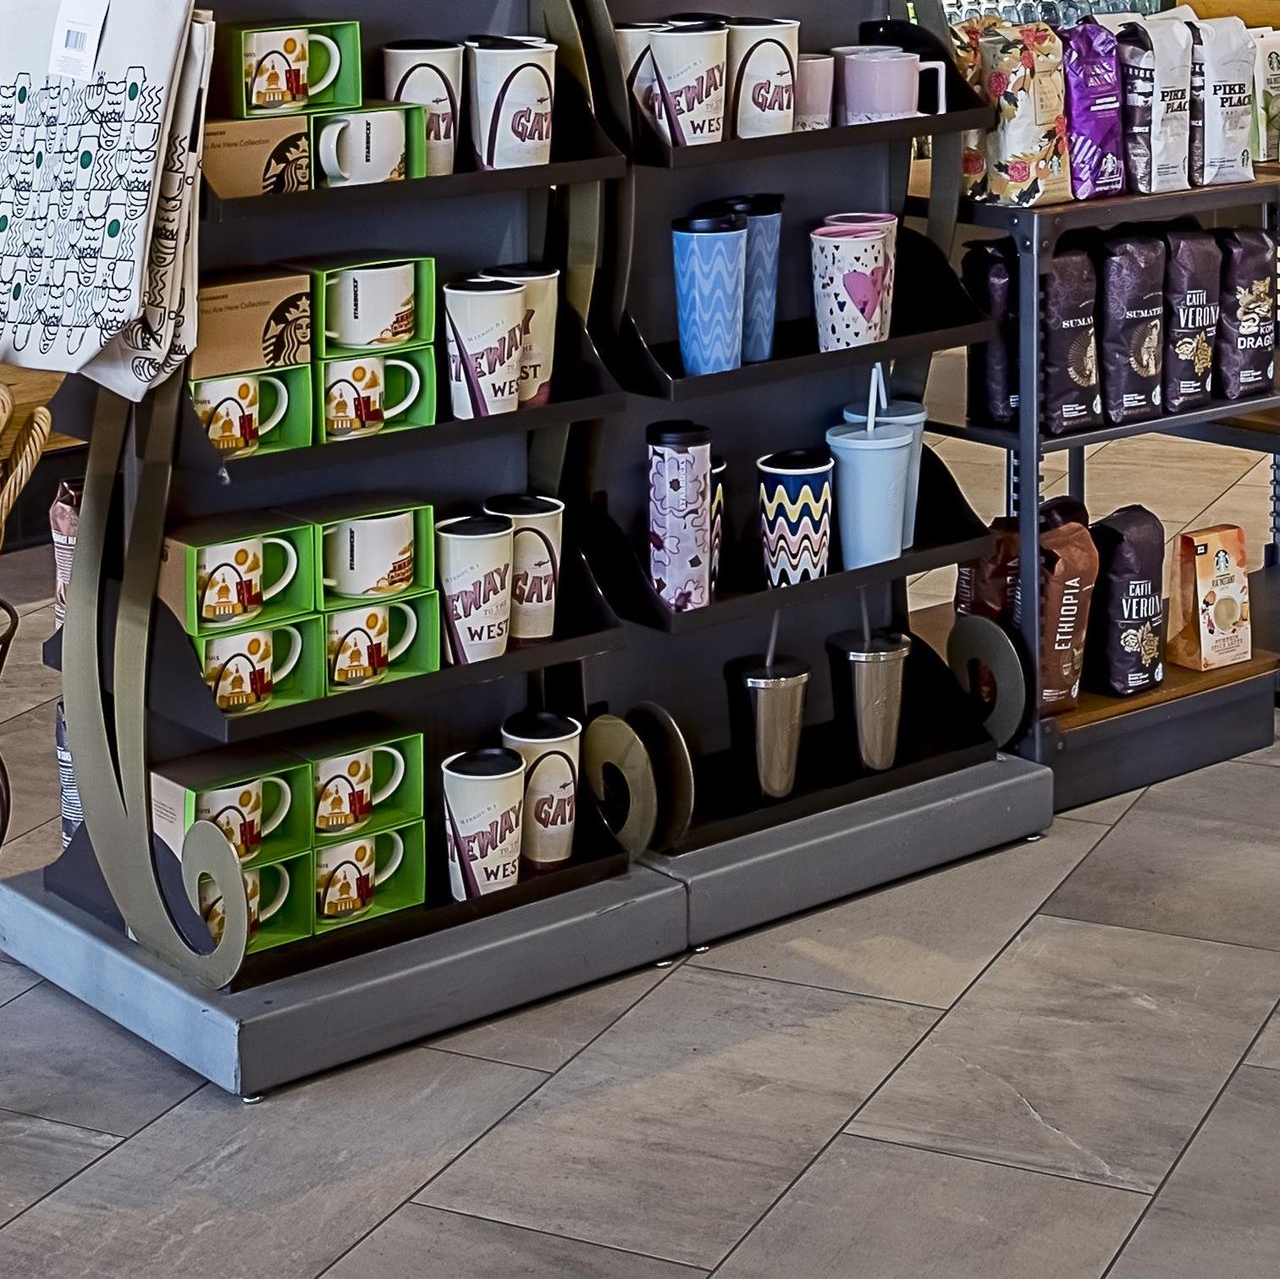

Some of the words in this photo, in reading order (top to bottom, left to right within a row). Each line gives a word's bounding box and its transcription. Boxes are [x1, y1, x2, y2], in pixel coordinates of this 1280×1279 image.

[1161, 89, 1187, 102] PIKE
[1213, 83, 1246, 96] PIKE
[1220, 94, 1252, 108] PLACE
[240, 138, 270, 147] Collection
[240, 300, 270, 309] Collection
[1054, 577, 1081, 652] ETHIOPIA
[467, 619, 509, 641] WEST
